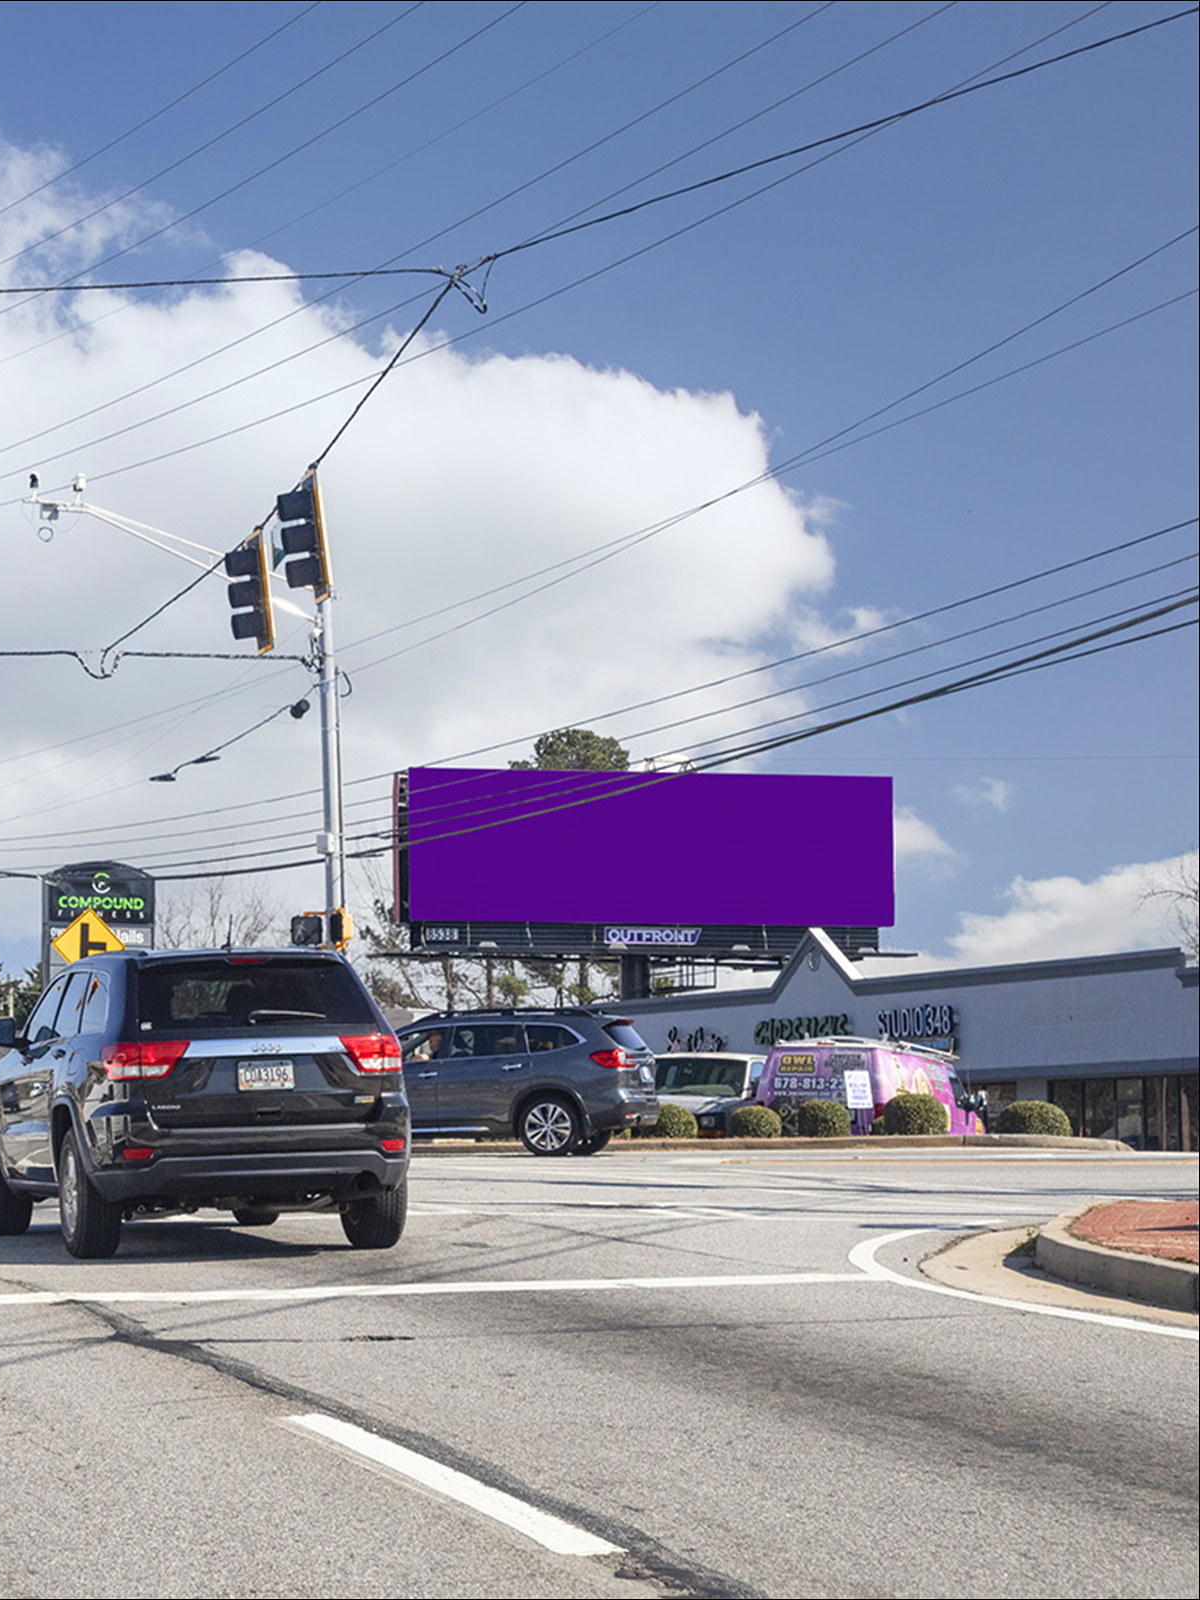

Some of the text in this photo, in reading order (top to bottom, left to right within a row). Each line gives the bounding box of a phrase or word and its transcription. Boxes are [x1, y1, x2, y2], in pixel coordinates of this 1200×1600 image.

[58, 895, 144, 910] COMPOUND
[57, 909, 145, 919] FINESS
[608, 928, 695, 943] OUTFRONT
[876, 1004, 951, 1038] STUDIO 348
[781, 1054, 814, 1065] OWL
[780, 1065, 814, 1073] REPAIR
